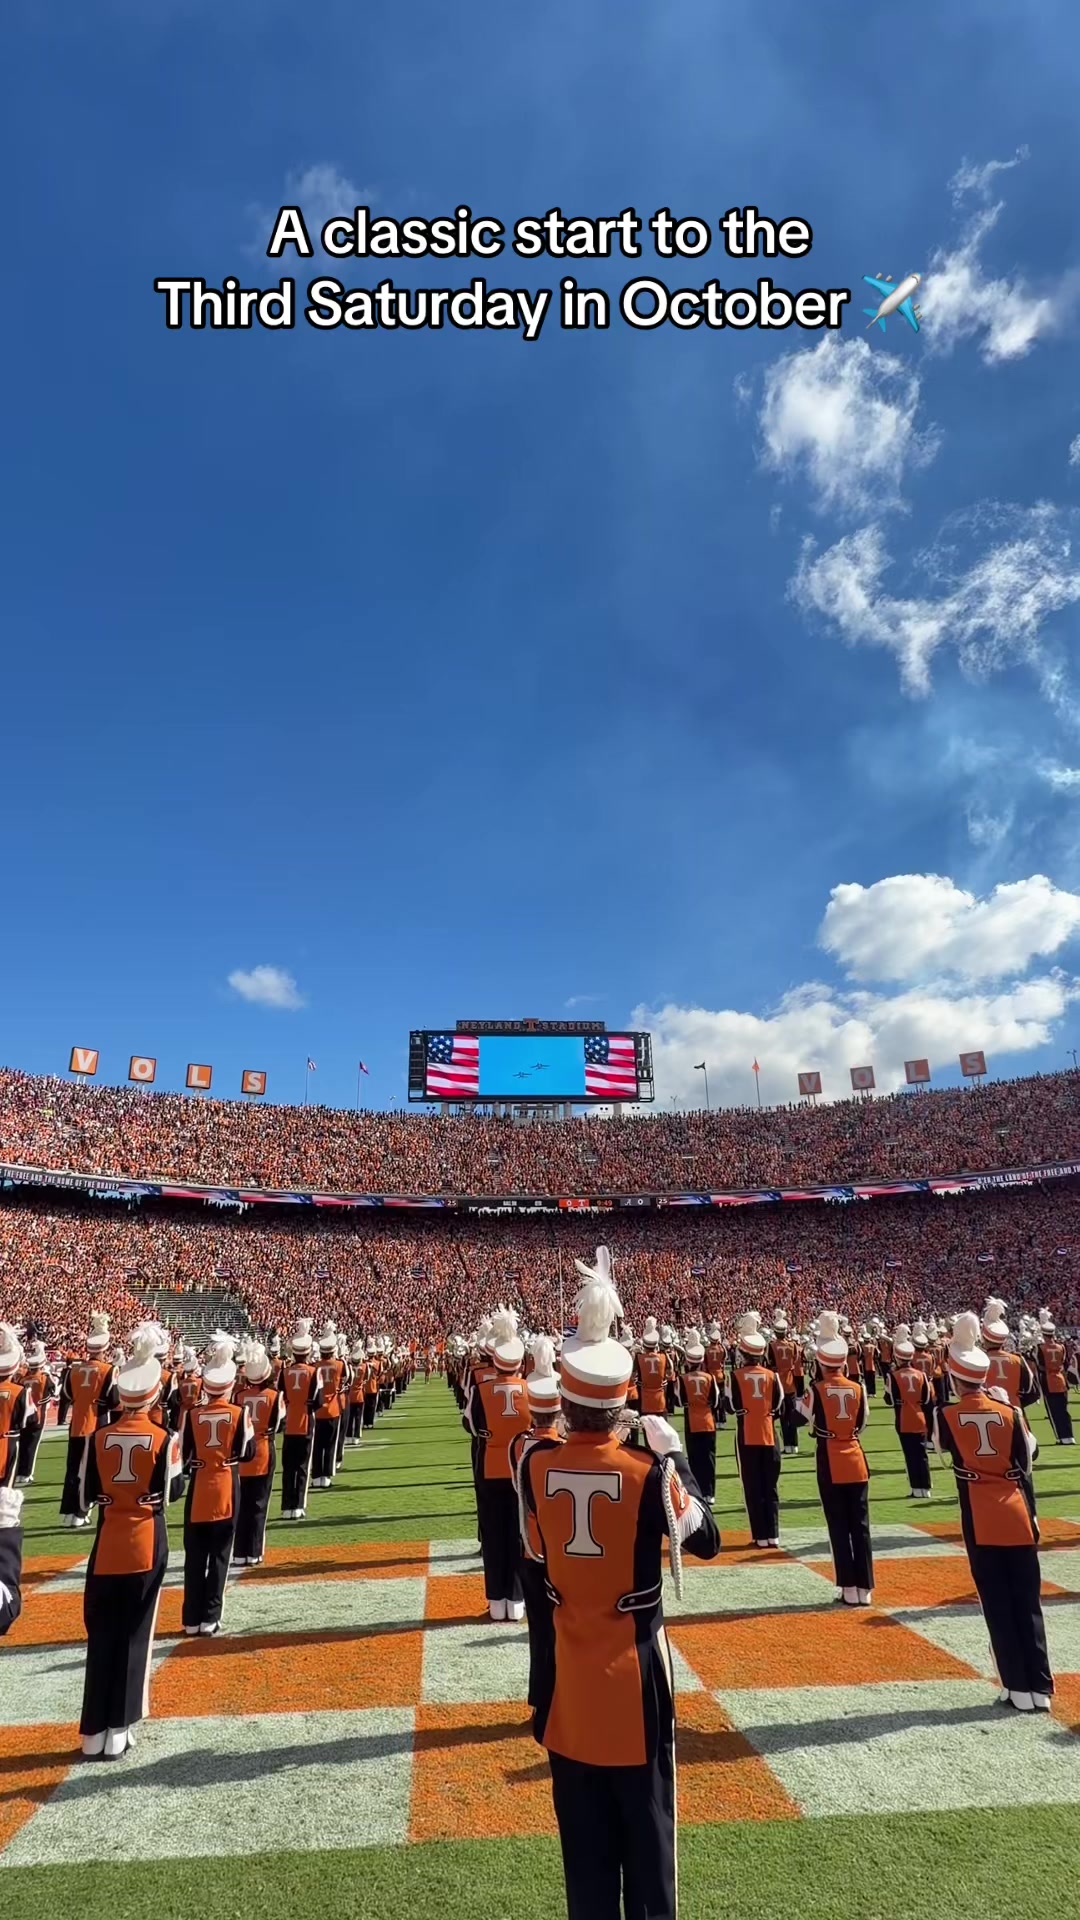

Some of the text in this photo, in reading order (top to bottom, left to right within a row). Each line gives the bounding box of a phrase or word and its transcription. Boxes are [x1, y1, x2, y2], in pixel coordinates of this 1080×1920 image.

[461, 1021, 520, 1030] NEYLAND
[542, 1021, 601, 1030] STADIUM
[4, 1169, 14, 1178] THE
[15, 1171, 29, 1180] FREE
[44, 1175, 55, 1183] THE
[84, 1180, 95, 1189] THE
[1043, 1168, 1058, 1177] FREE
[645, 1357, 660, 1374] T
[989, 1356, 1009, 1379] T
[79, 1367, 99, 1387] T
[288, 1369, 308, 1390] T
[688, 1376, 707, 1395] T
[744, 1373, 767, 1398] T
[901, 1373, 919, 1392] T
[182, 1382, 198, 1397] T
[493, 1383, 524, 1417] T
[244, 1396, 268, 1421] T
[826, 1387, 856, 1419] T
[198, 1411, 233, 1447] T
[958, 1411, 1005, 1456] T
[104, 1433, 153, 1483] T
[545, 1469, 622, 1557] T
